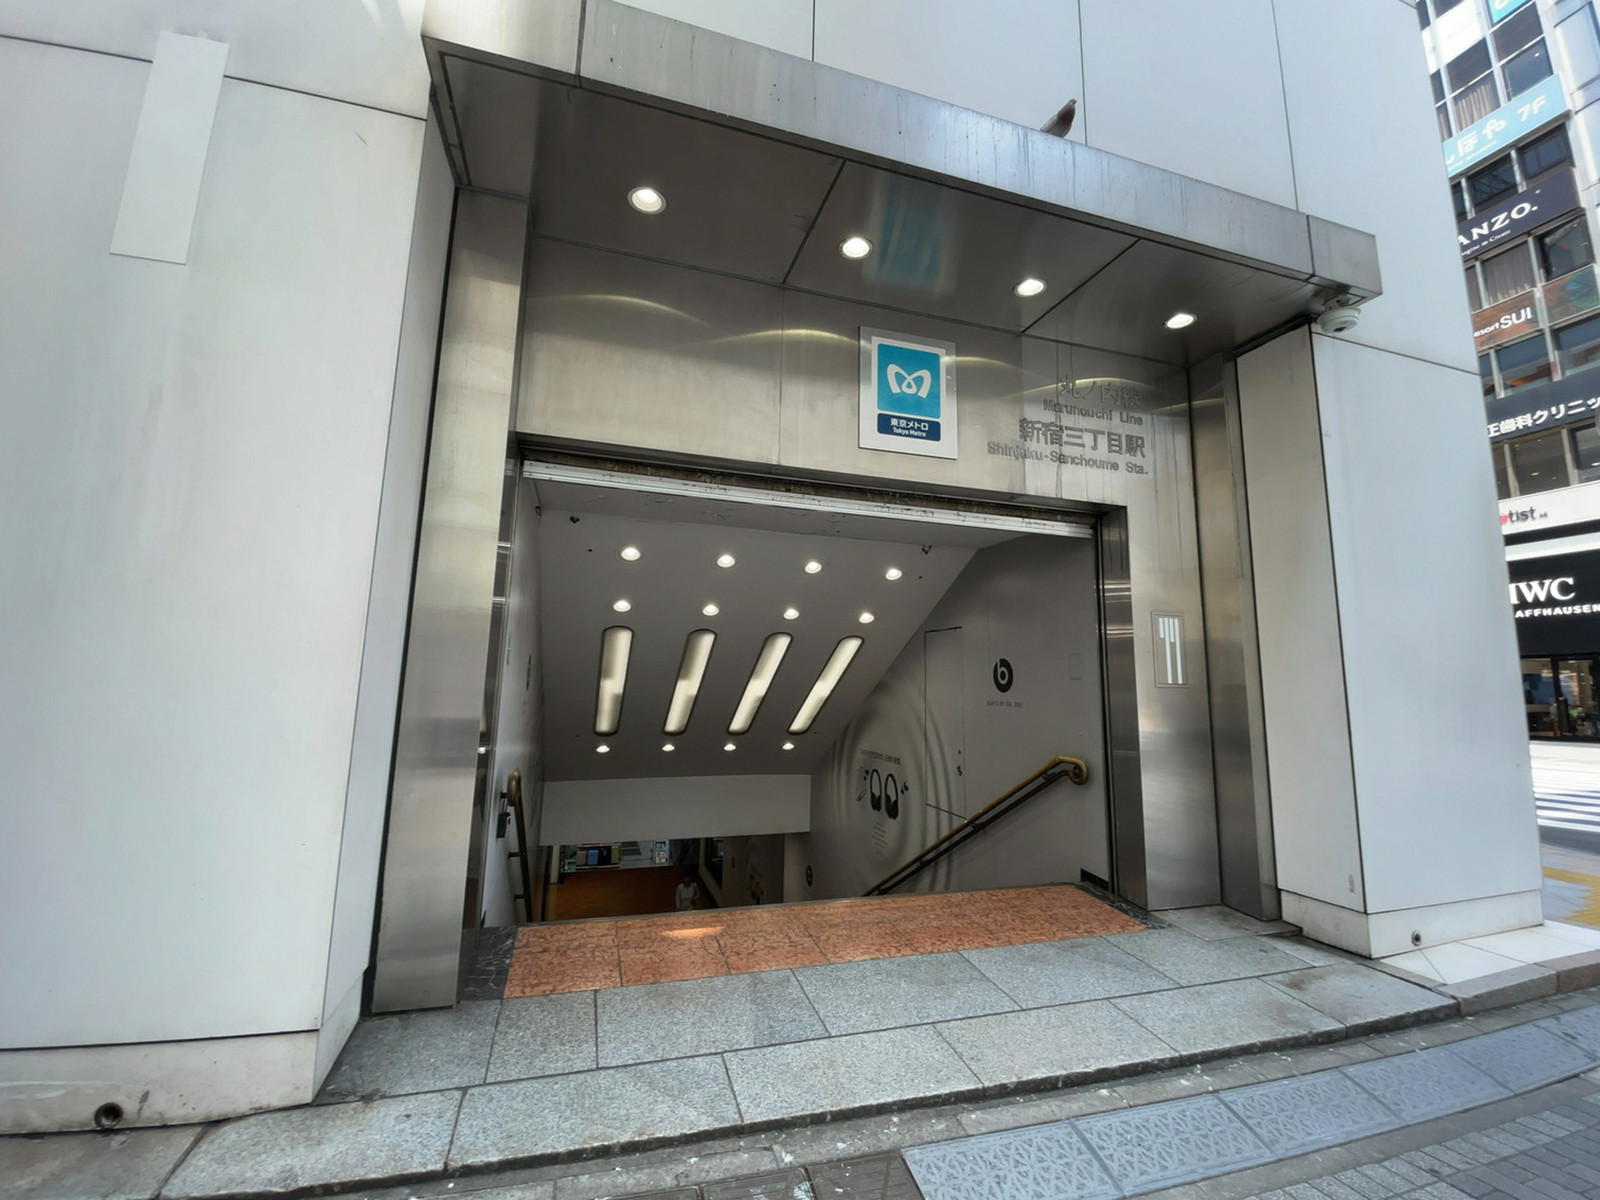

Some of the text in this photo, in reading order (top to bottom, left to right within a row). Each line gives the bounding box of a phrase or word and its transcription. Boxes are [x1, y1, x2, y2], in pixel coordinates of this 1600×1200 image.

[1517, 95, 1546, 122] 7F
[1457, 202, 1538, 245] ANZO.
[1500, 307, 1532, 329] SUI
[890, 418, 929, 431] 東京メトロ
[1043, 399, 1144, 426] Marunouchi Line
[892, 427, 927, 438] Tokyo Metro
[1019, 418, 1146, 459] 新宿三丁目駅
[987, 441, 1149, 475] Shinjuku-Sanchoume Sta.
[1509, 577, 1576, 605] IWC
[1515, 604, 1600, 618] AFFHAUSEN
